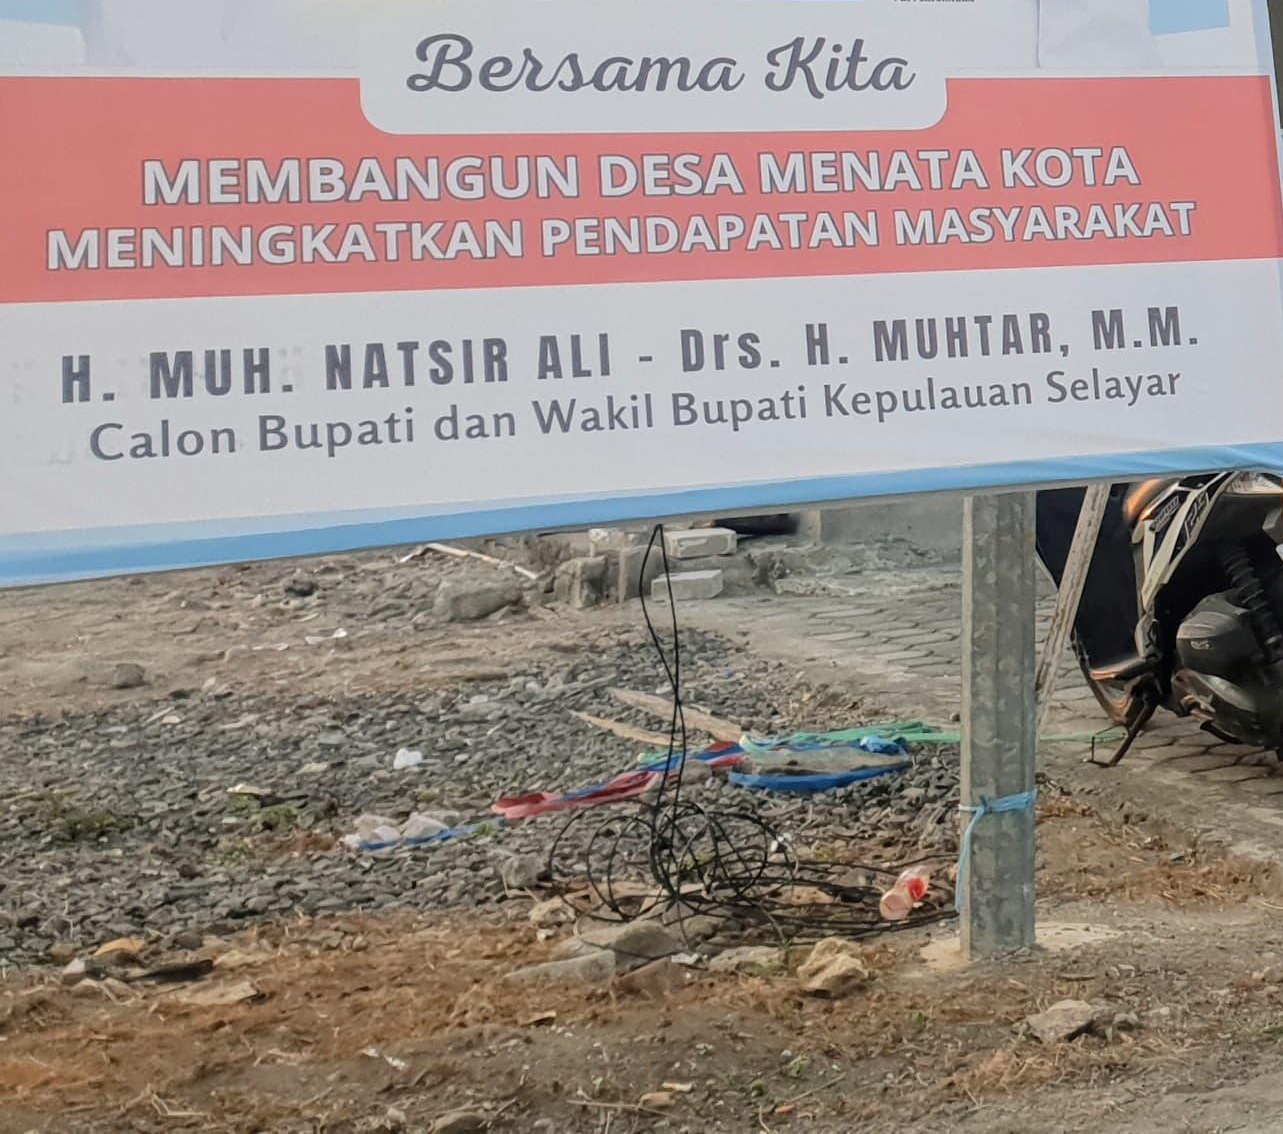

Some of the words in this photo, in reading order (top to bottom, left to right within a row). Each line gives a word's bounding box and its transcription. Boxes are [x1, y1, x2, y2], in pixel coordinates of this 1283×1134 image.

[406, 34, 745, 92] Bersama
[766, 37, 915, 99] Kita
[141, 154, 582, 208] MEMBANGUN
[597, 150, 743, 199] DESA
[757, 146, 988, 196] MENATA
[1000, 144, 1142, 188] KOTA
[46, 222, 526, 270] MENINGKATKAN
[540, 210, 882, 258] PENDAPATAN
[893, 199, 1198, 245] MASYARAKAT
[62, 354, 116, 403] H.
[149, 348, 295, 400] MUH.
[323, 338, 509, 391] NATSIR
[537, 332, 612, 380] ALI
[680, 326, 781, 373] Drs.
[804, 322, 852, 366] H.
[875, 314, 1070, 360] MUHTAR,
[1091, 306, 1200, 351] M.M.
[88, 418, 237, 462] Calon
[257, 407, 414, 458] Bupati
[433, 401, 518, 442] dan
[532, 394, 656, 434] Wakil
[671, 386, 806, 430] Bupati
[822, 375, 1032, 424] Kepulauan
[1045, 366, 1182, 407] Selayar
